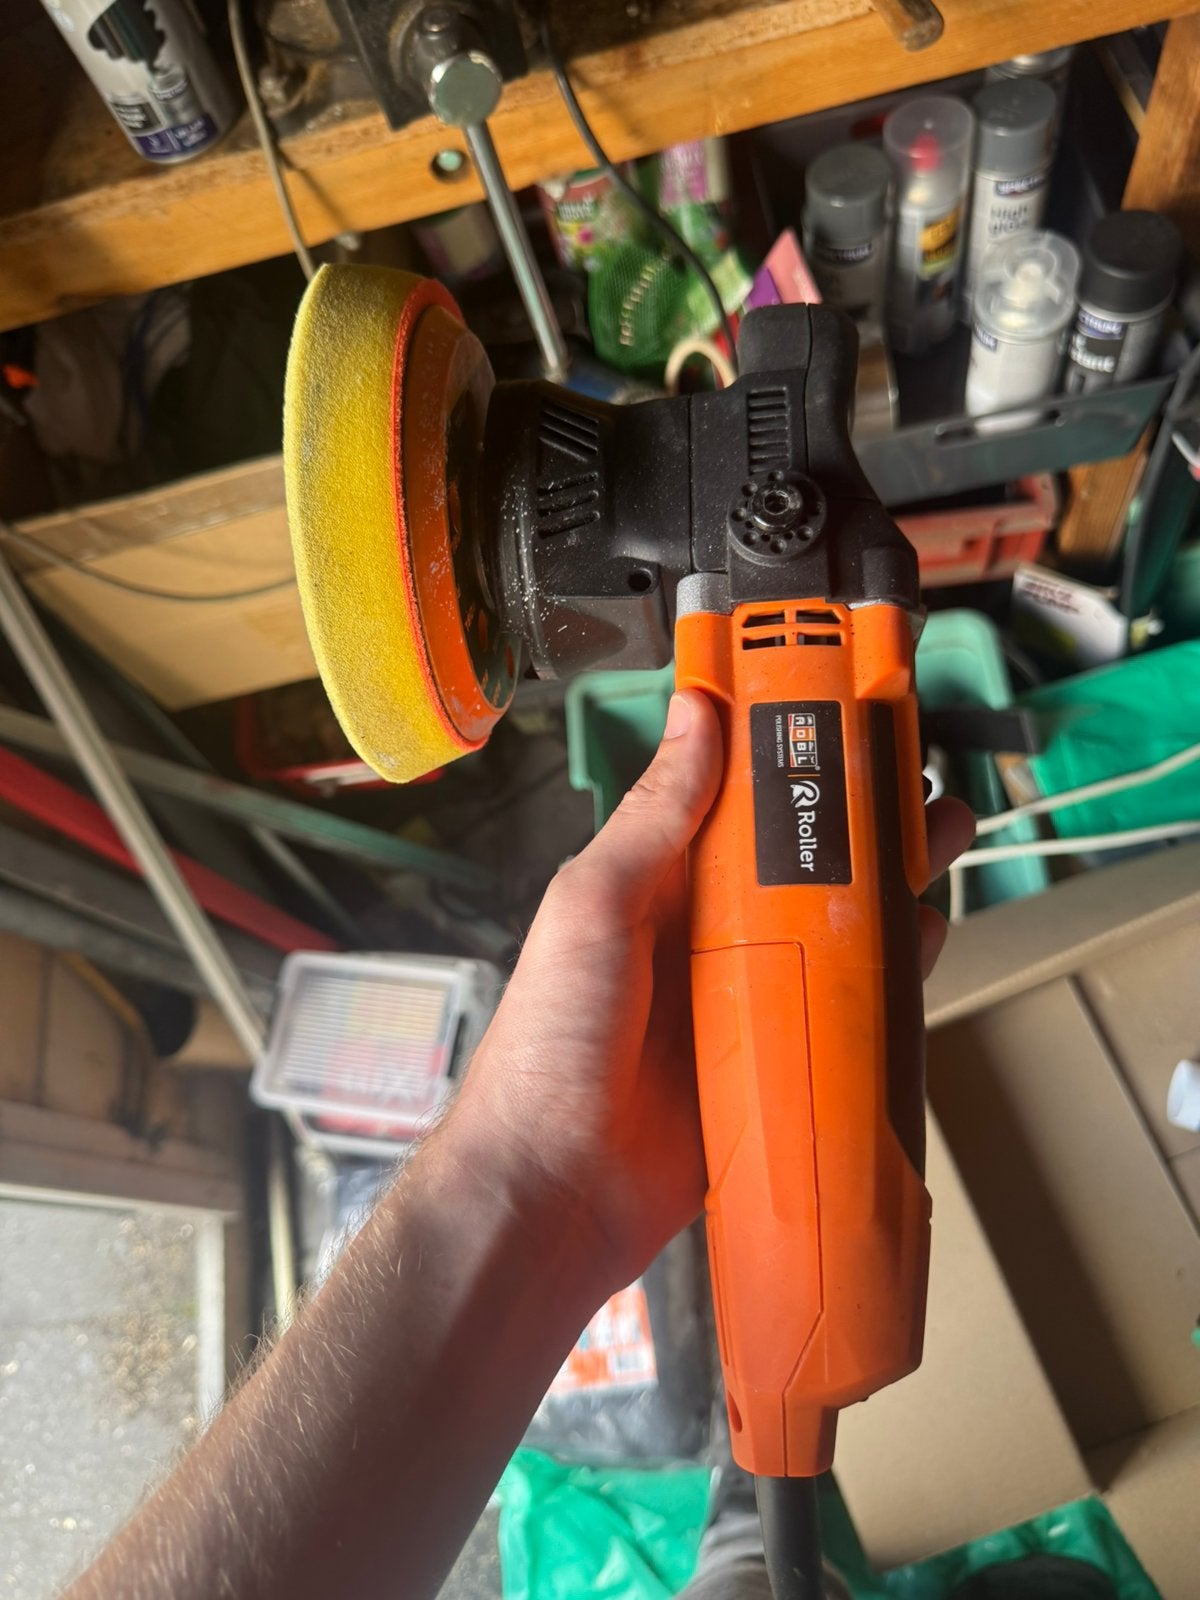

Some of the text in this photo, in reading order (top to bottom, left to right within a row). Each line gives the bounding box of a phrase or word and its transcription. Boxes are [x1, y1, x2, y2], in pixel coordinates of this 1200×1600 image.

[775, 715, 784, 768] POLISHING SYSTEMS
[794, 716, 807, 765] ADBL
[797, 810, 817, 872] Roller
